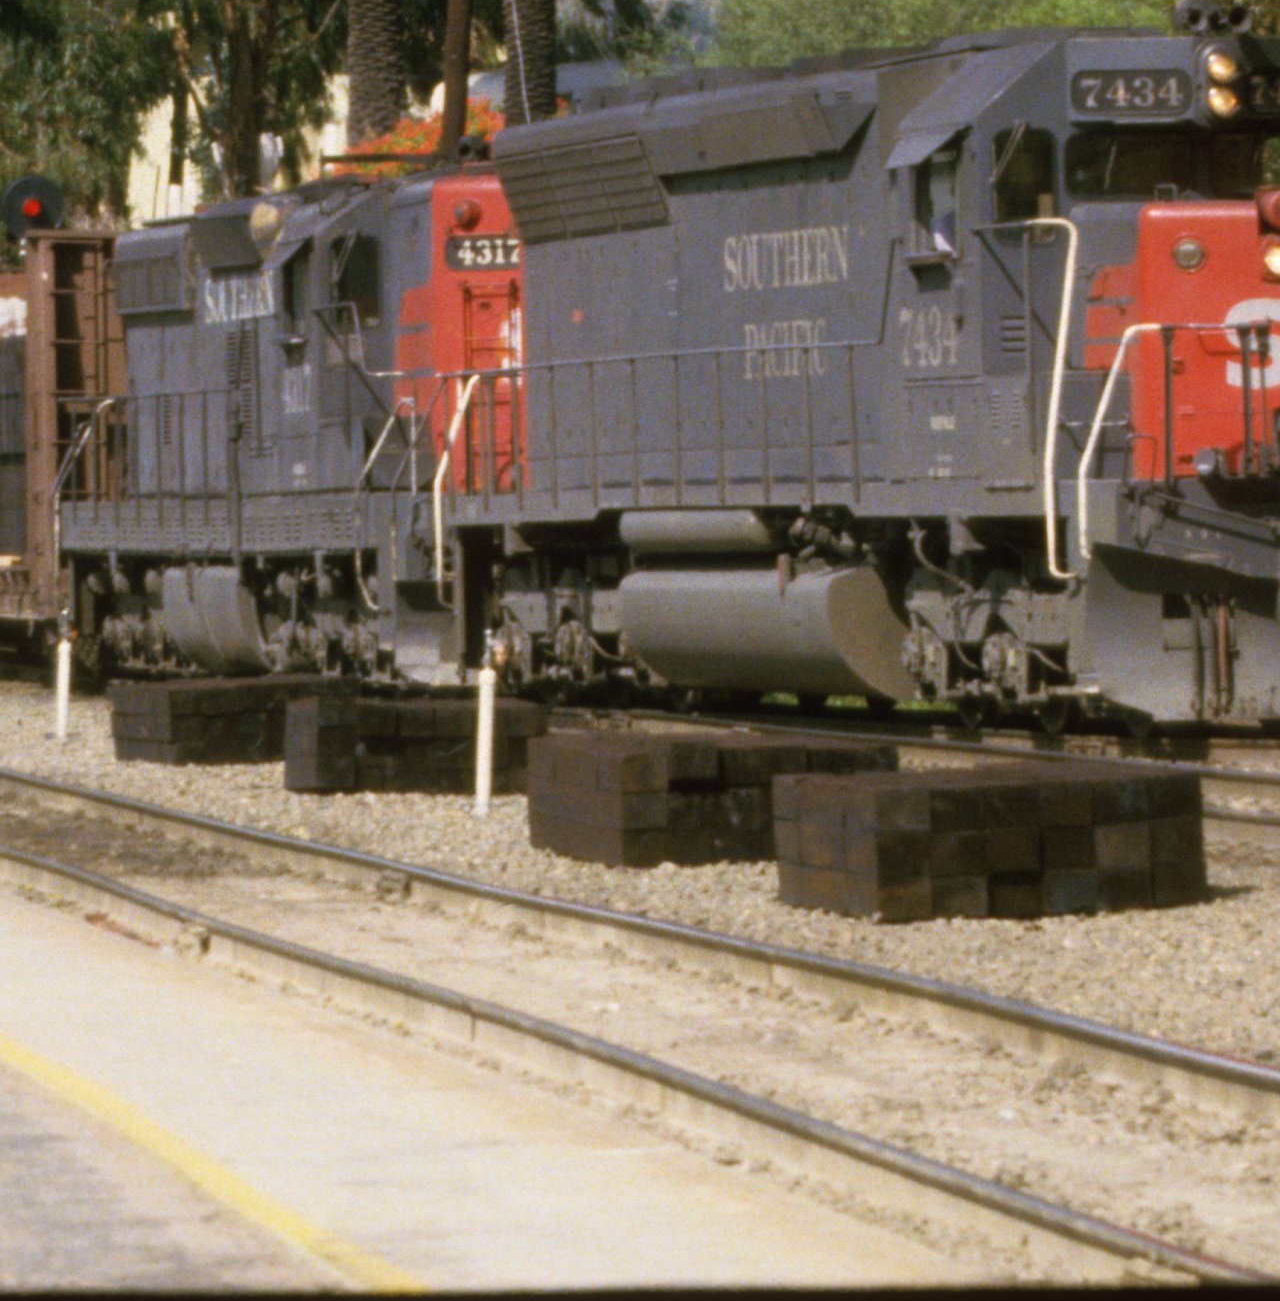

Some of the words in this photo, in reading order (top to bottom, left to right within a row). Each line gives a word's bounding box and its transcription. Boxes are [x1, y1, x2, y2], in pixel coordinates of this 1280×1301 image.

[1080, 77, 1184, 108] 7434
[457, 239, 521, 267] 4317
[723, 224, 850, 293] SOUTHERN
[742, 318, 827, 381] PACIFIC
[898, 305, 959, 367] 7434
